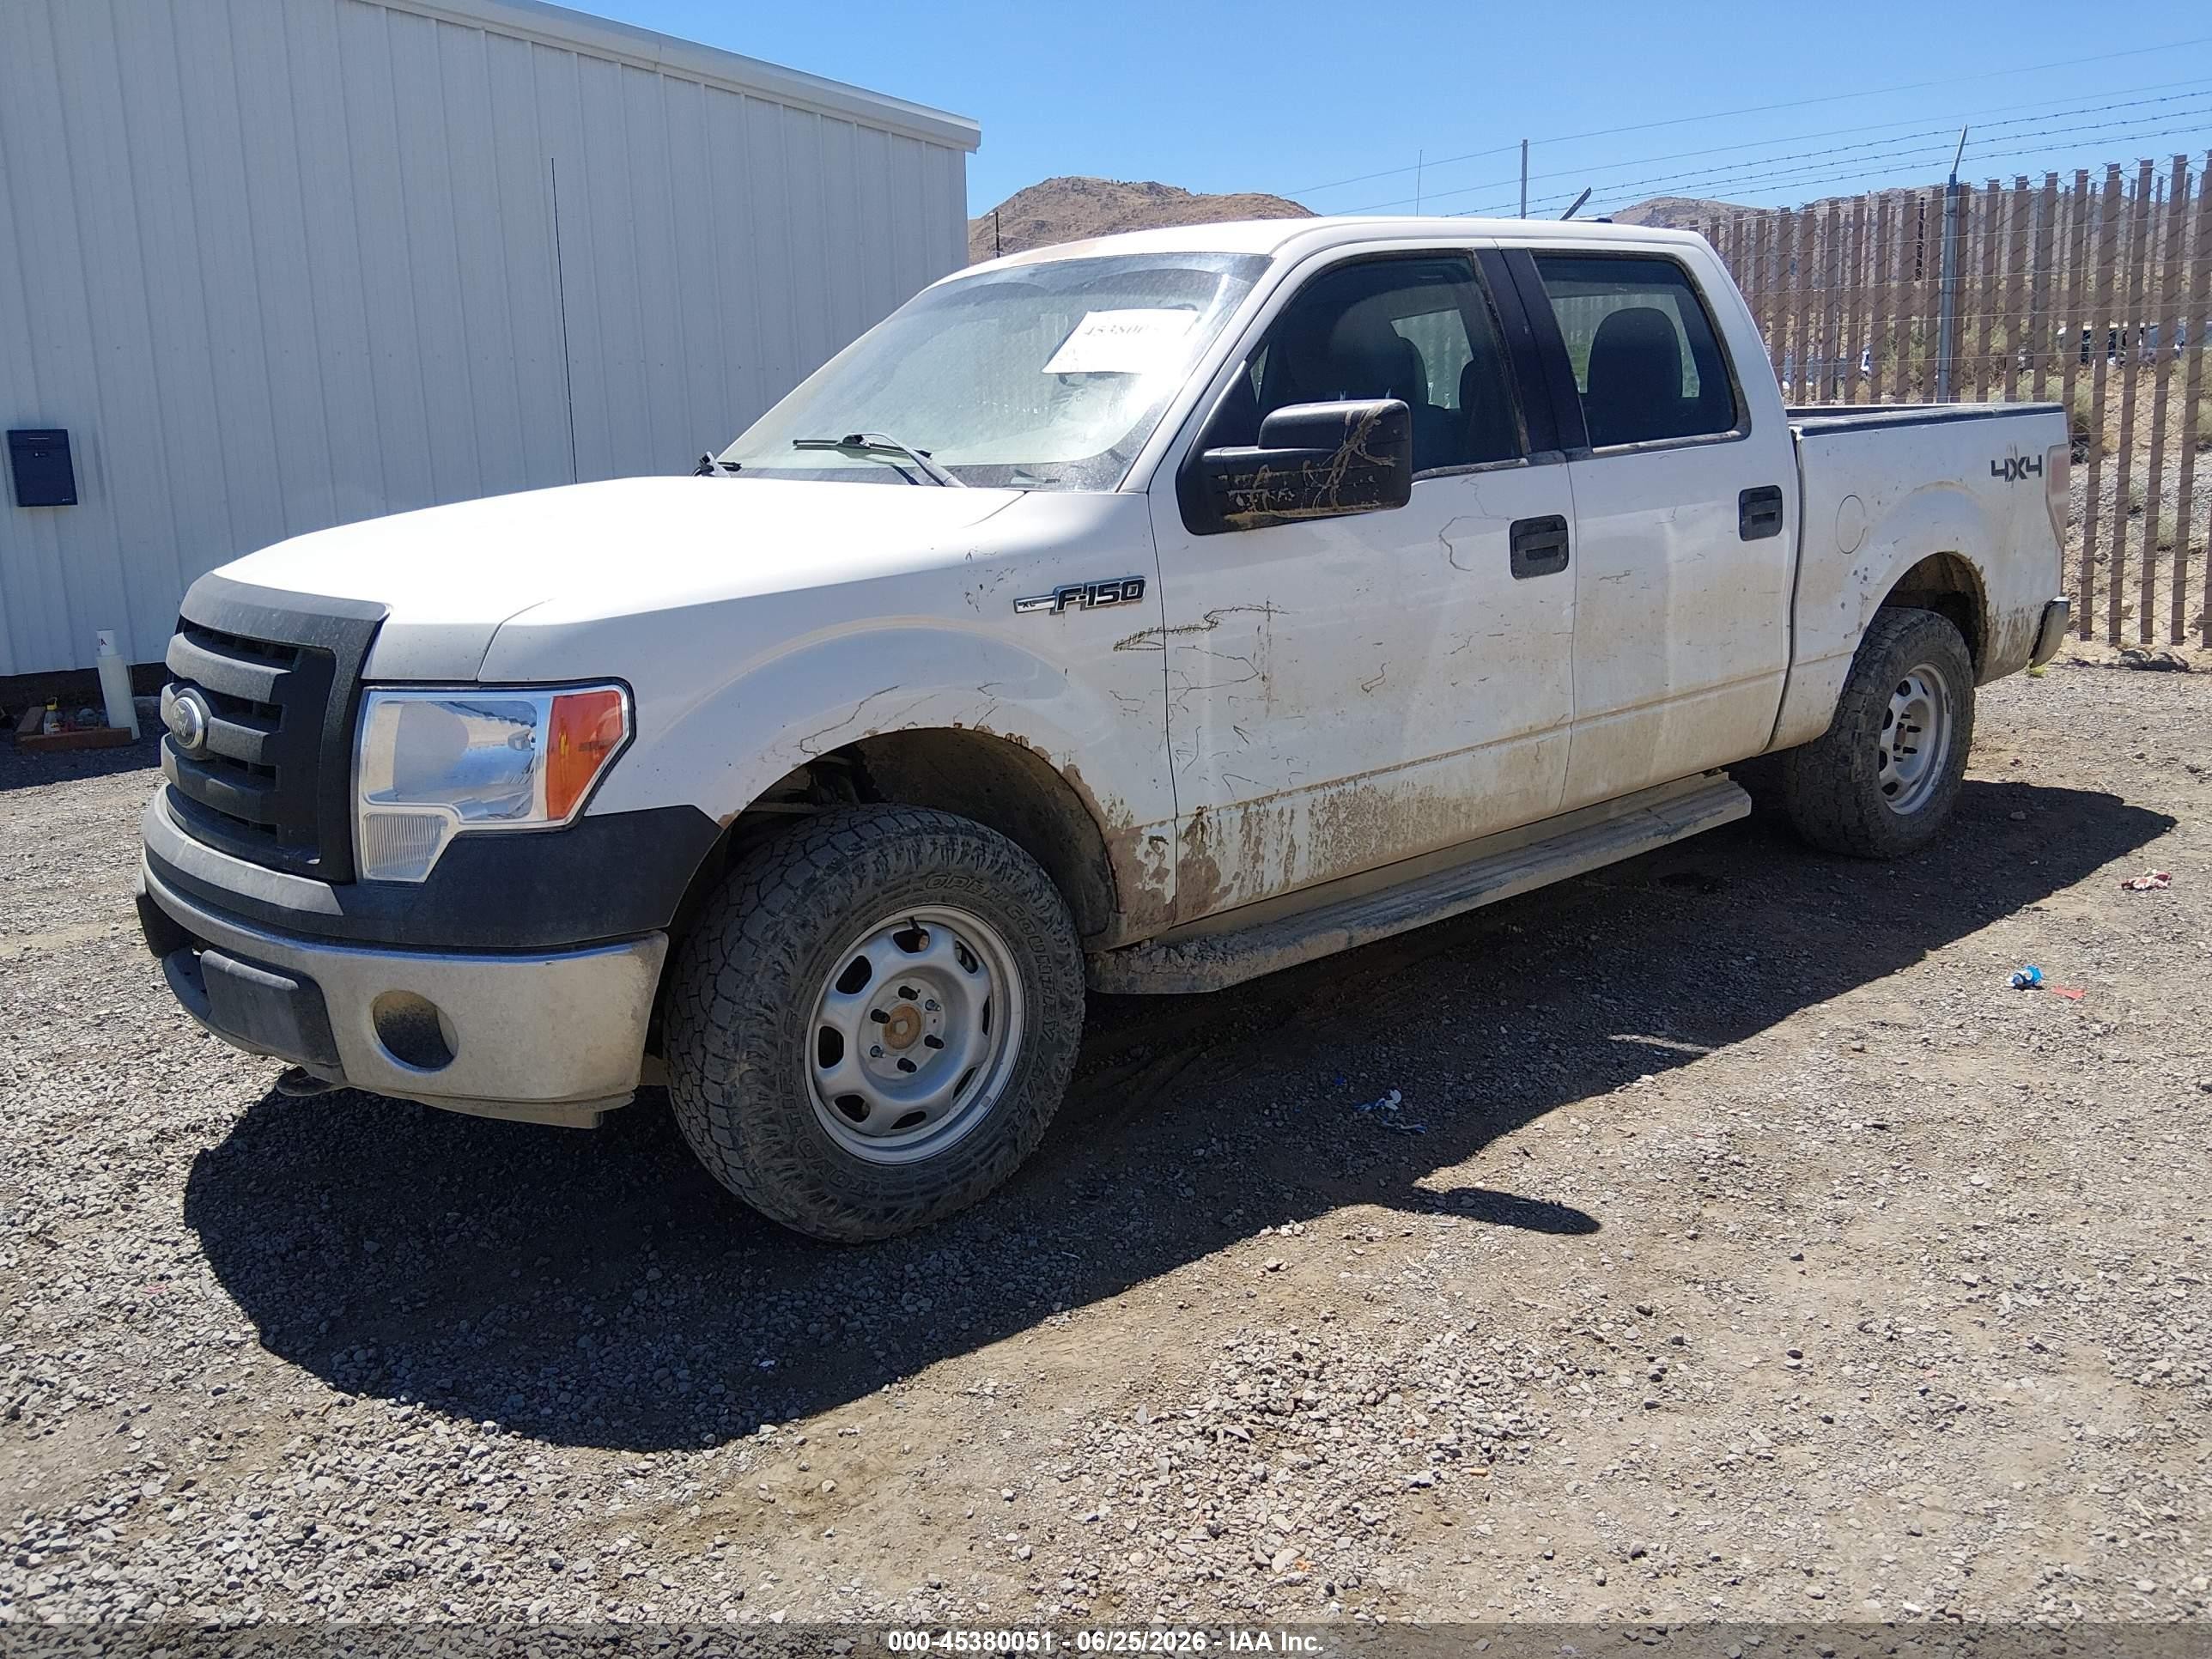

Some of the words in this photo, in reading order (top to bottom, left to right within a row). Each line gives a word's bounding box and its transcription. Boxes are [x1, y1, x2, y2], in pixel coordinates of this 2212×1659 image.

[1055, 576, 1147, 612] F-150
[926, 872, 1003, 902] OPEN
[797, 1137, 870, 1197] TOYO
